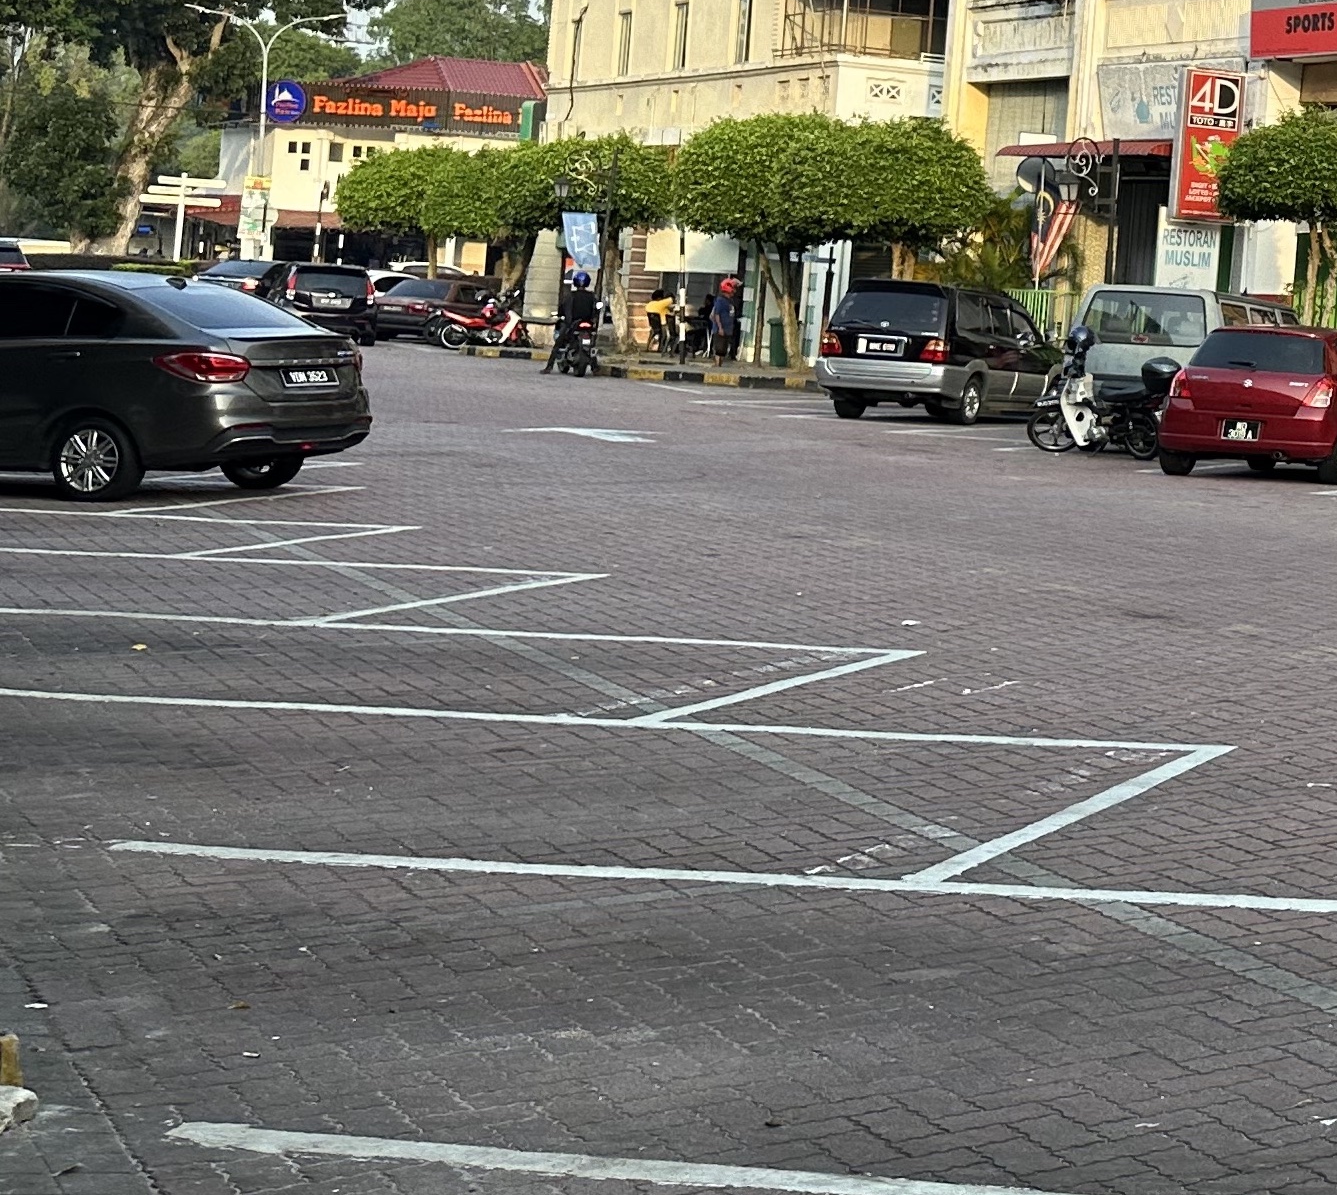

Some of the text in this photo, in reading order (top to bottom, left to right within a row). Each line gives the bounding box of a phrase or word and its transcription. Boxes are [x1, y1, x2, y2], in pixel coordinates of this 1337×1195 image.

[1285, 12, 1334, 34] SPORTS
[1191, 77, 1240, 114] 4D
[313, 95, 384, 116] Fazlina
[389, 100, 437, 122] Maju
[454, 103, 512, 125] Fazlina
[1192, 116, 1214, 125] TOTO
[1163, 228, 1216, 249] RESTORAN
[1165, 250, 1212, 267] MUSLIM
